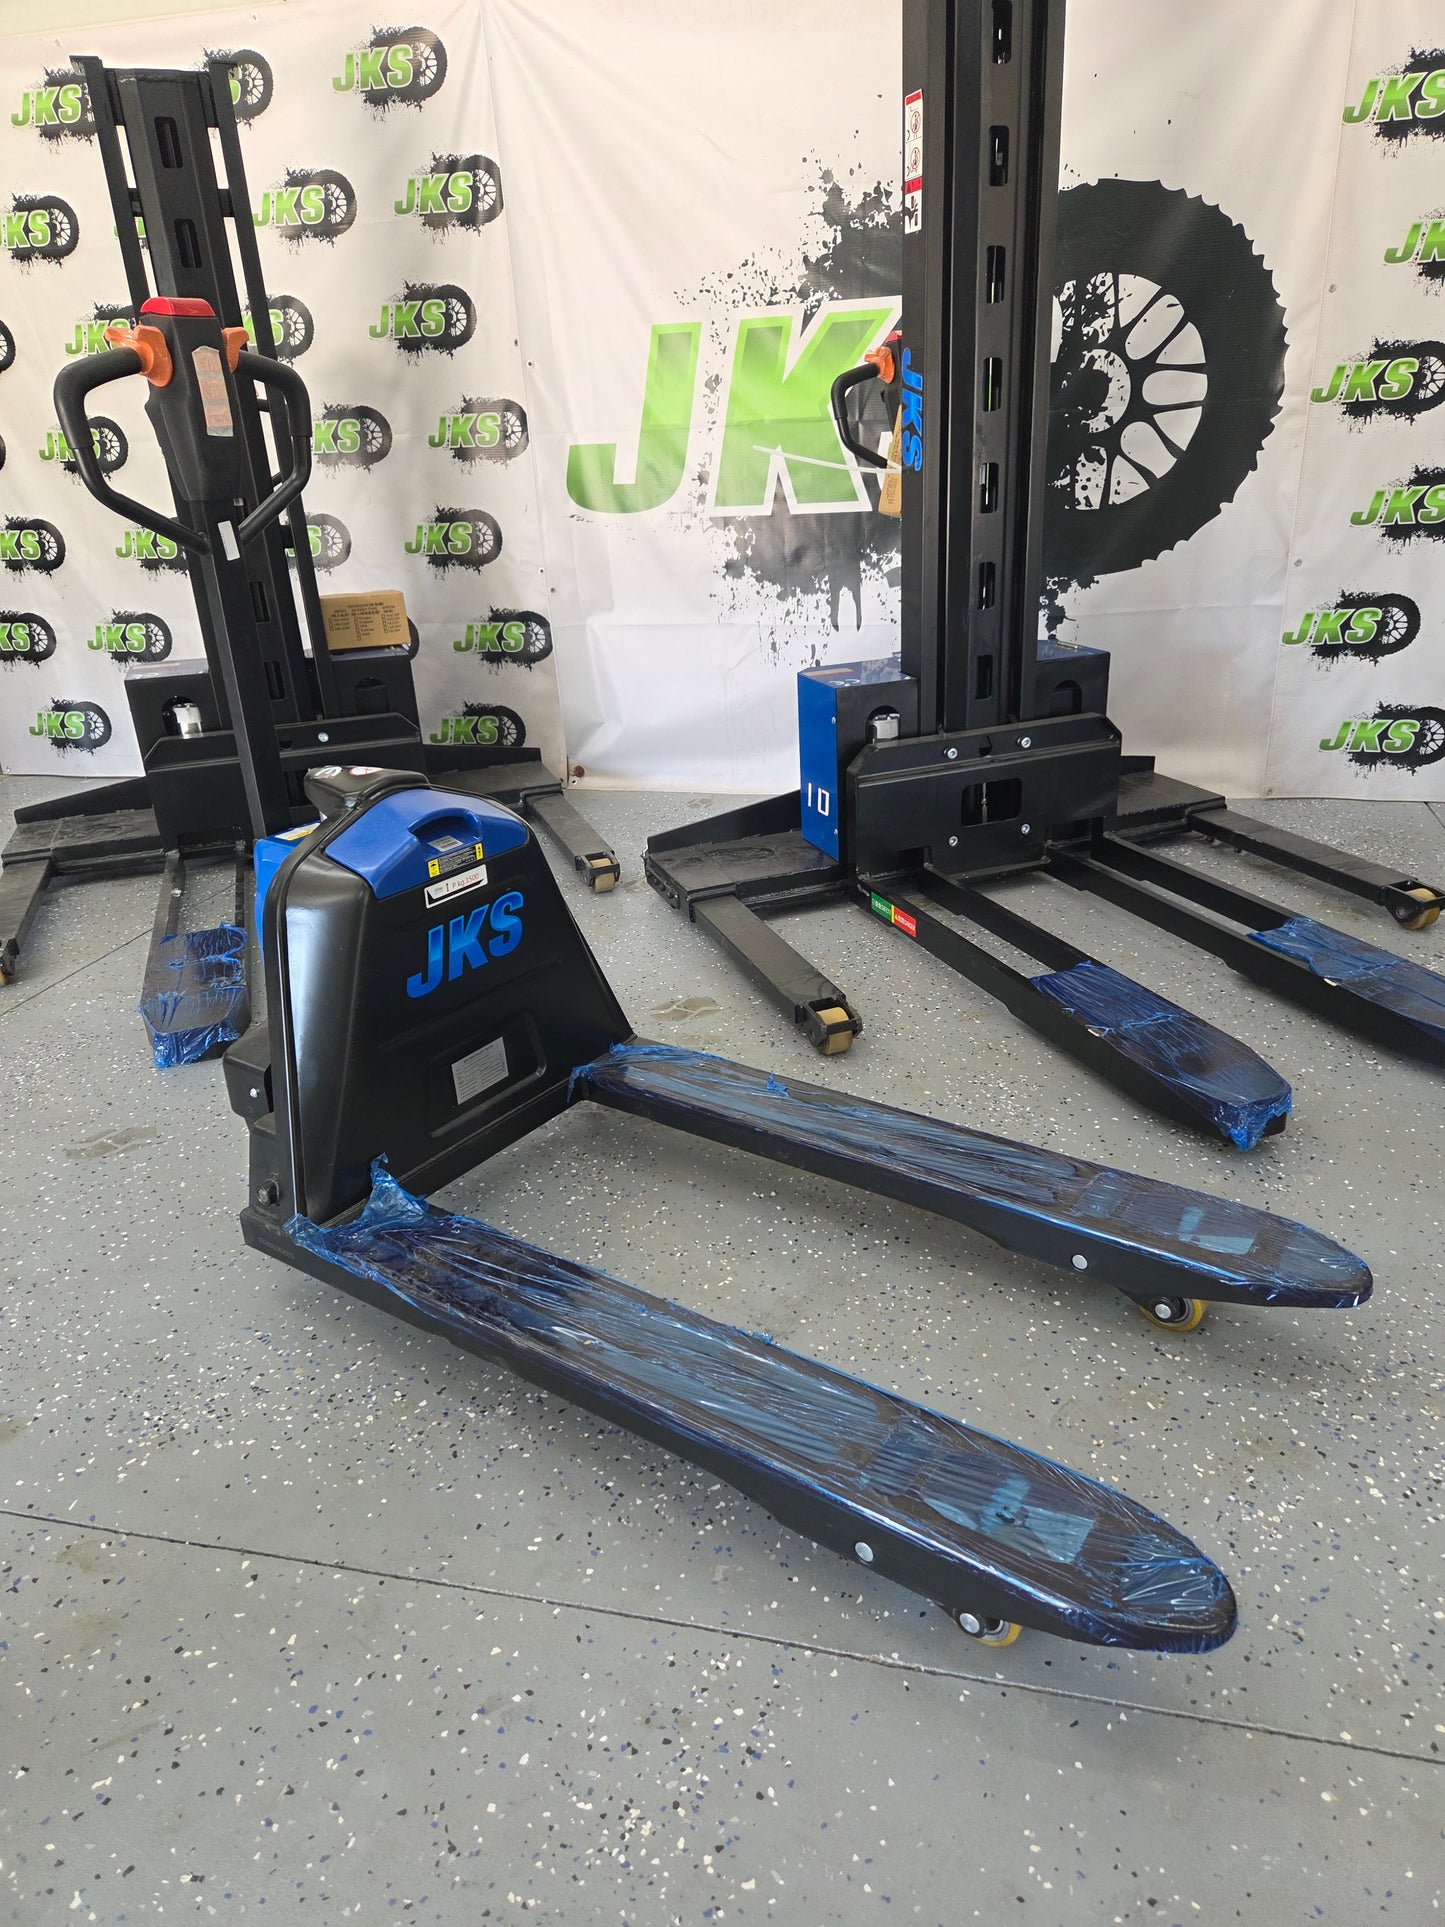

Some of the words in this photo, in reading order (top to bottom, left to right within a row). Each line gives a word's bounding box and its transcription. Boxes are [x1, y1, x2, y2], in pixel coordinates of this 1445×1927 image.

[332, 44, 413, 92] JKS
[11, 84, 82, 127] JKS
[1342, 70, 1445, 124] JKS
[252, 185, 325, 227] JKS
[394, 171, 473, 215] JKS
[3, 210, 51, 249] KS
[1383, 220, 1445, 265] JK
[369, 299, 446, 339] JKS
[1310, 358, 1418, 404] JKS
[566, 296, 902, 517] JK
[902, 346, 923, 472] JKS
[312, 419, 361, 454] KS
[428, 412, 501, 448] JKS
[1350, 485, 1445, 526] JKS
[0, 529, 42, 560] KS
[115, 529, 178, 560] JKS
[404, 522, 473, 555] JKS
[0, 622, 31, 652] KS
[87, 623, 147, 652] JKS
[453, 622, 525, 653] JKS
[1282, 608, 1382, 646] JKS
[29, 711, 86, 740] JKS
[429, 715, 500, 744] JKS
[1319, 719, 1421, 753] JKS
[406, 891, 524, 999] JKS
